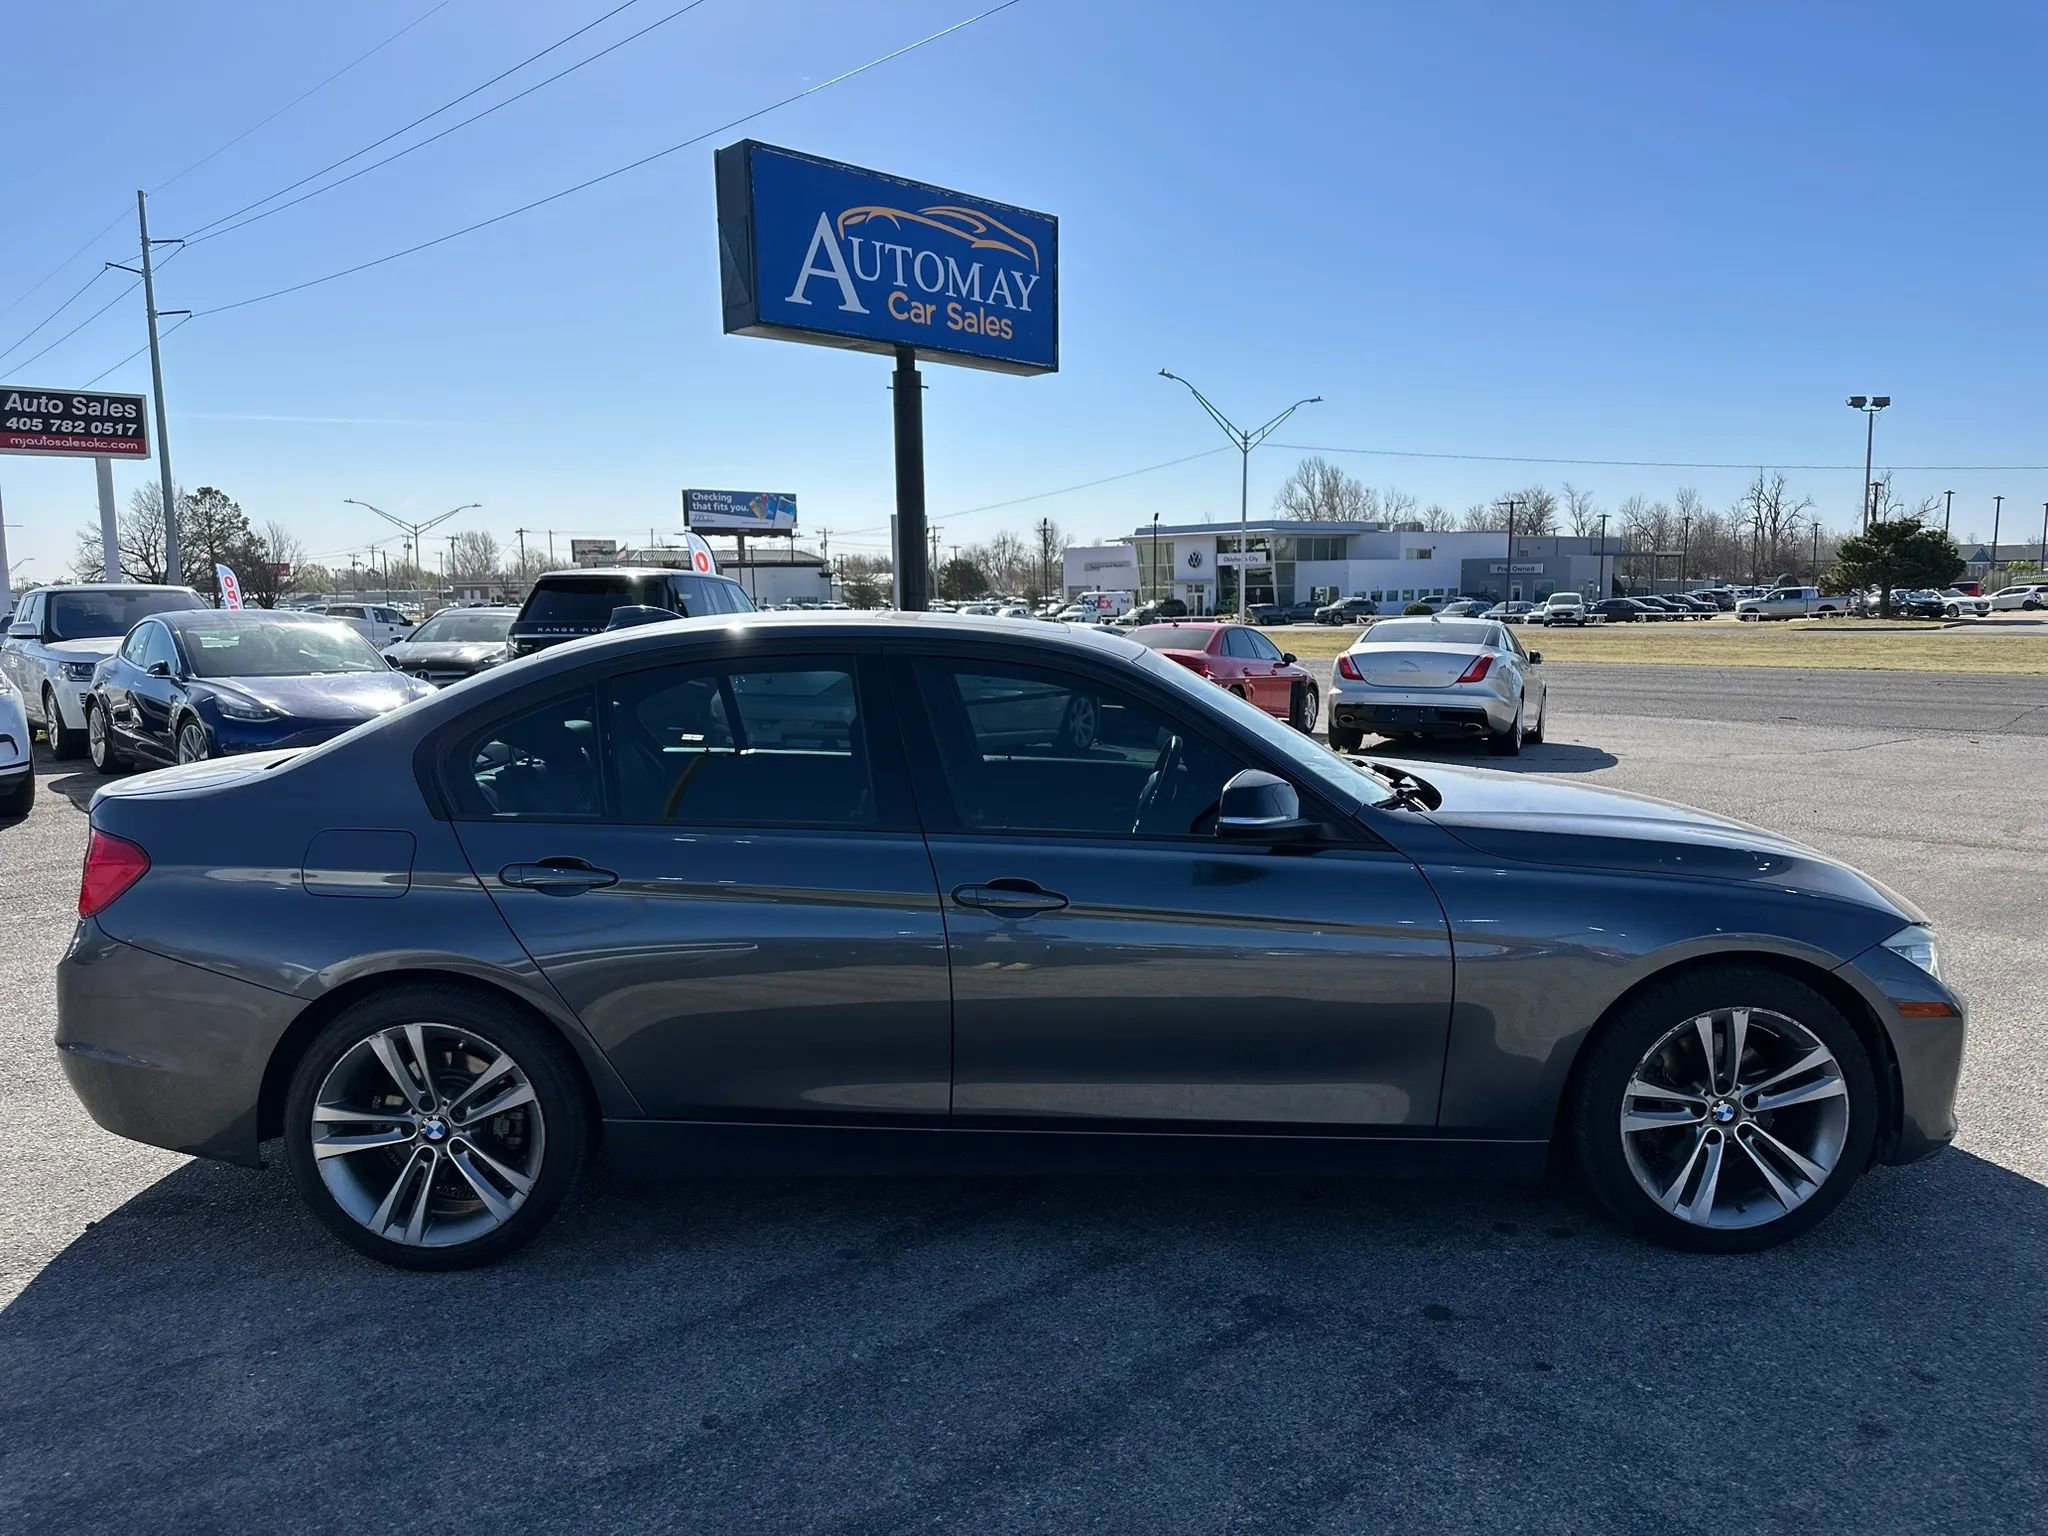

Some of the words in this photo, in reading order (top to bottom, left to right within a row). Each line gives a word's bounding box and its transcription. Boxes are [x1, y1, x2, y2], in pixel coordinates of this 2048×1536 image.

[785, 211, 1040, 315] AUTOMAY
[887, 291, 936, 326] Car
[946, 302, 1014, 340] Sales
[4, 392, 64, 414] Auto
[72, 396, 137, 418] Sales
[6, 417, 43, 431] 405
[50, 419, 86, 433] 782
[90, 421, 138, 436] 0517
[10, 436, 138, 450] mjautosalesokc.com
[692, 492, 732, 504] Checking
[692, 502, 712, 511] that
[713, 502, 729, 511] fits
[730, 504, 750, 513] you.
